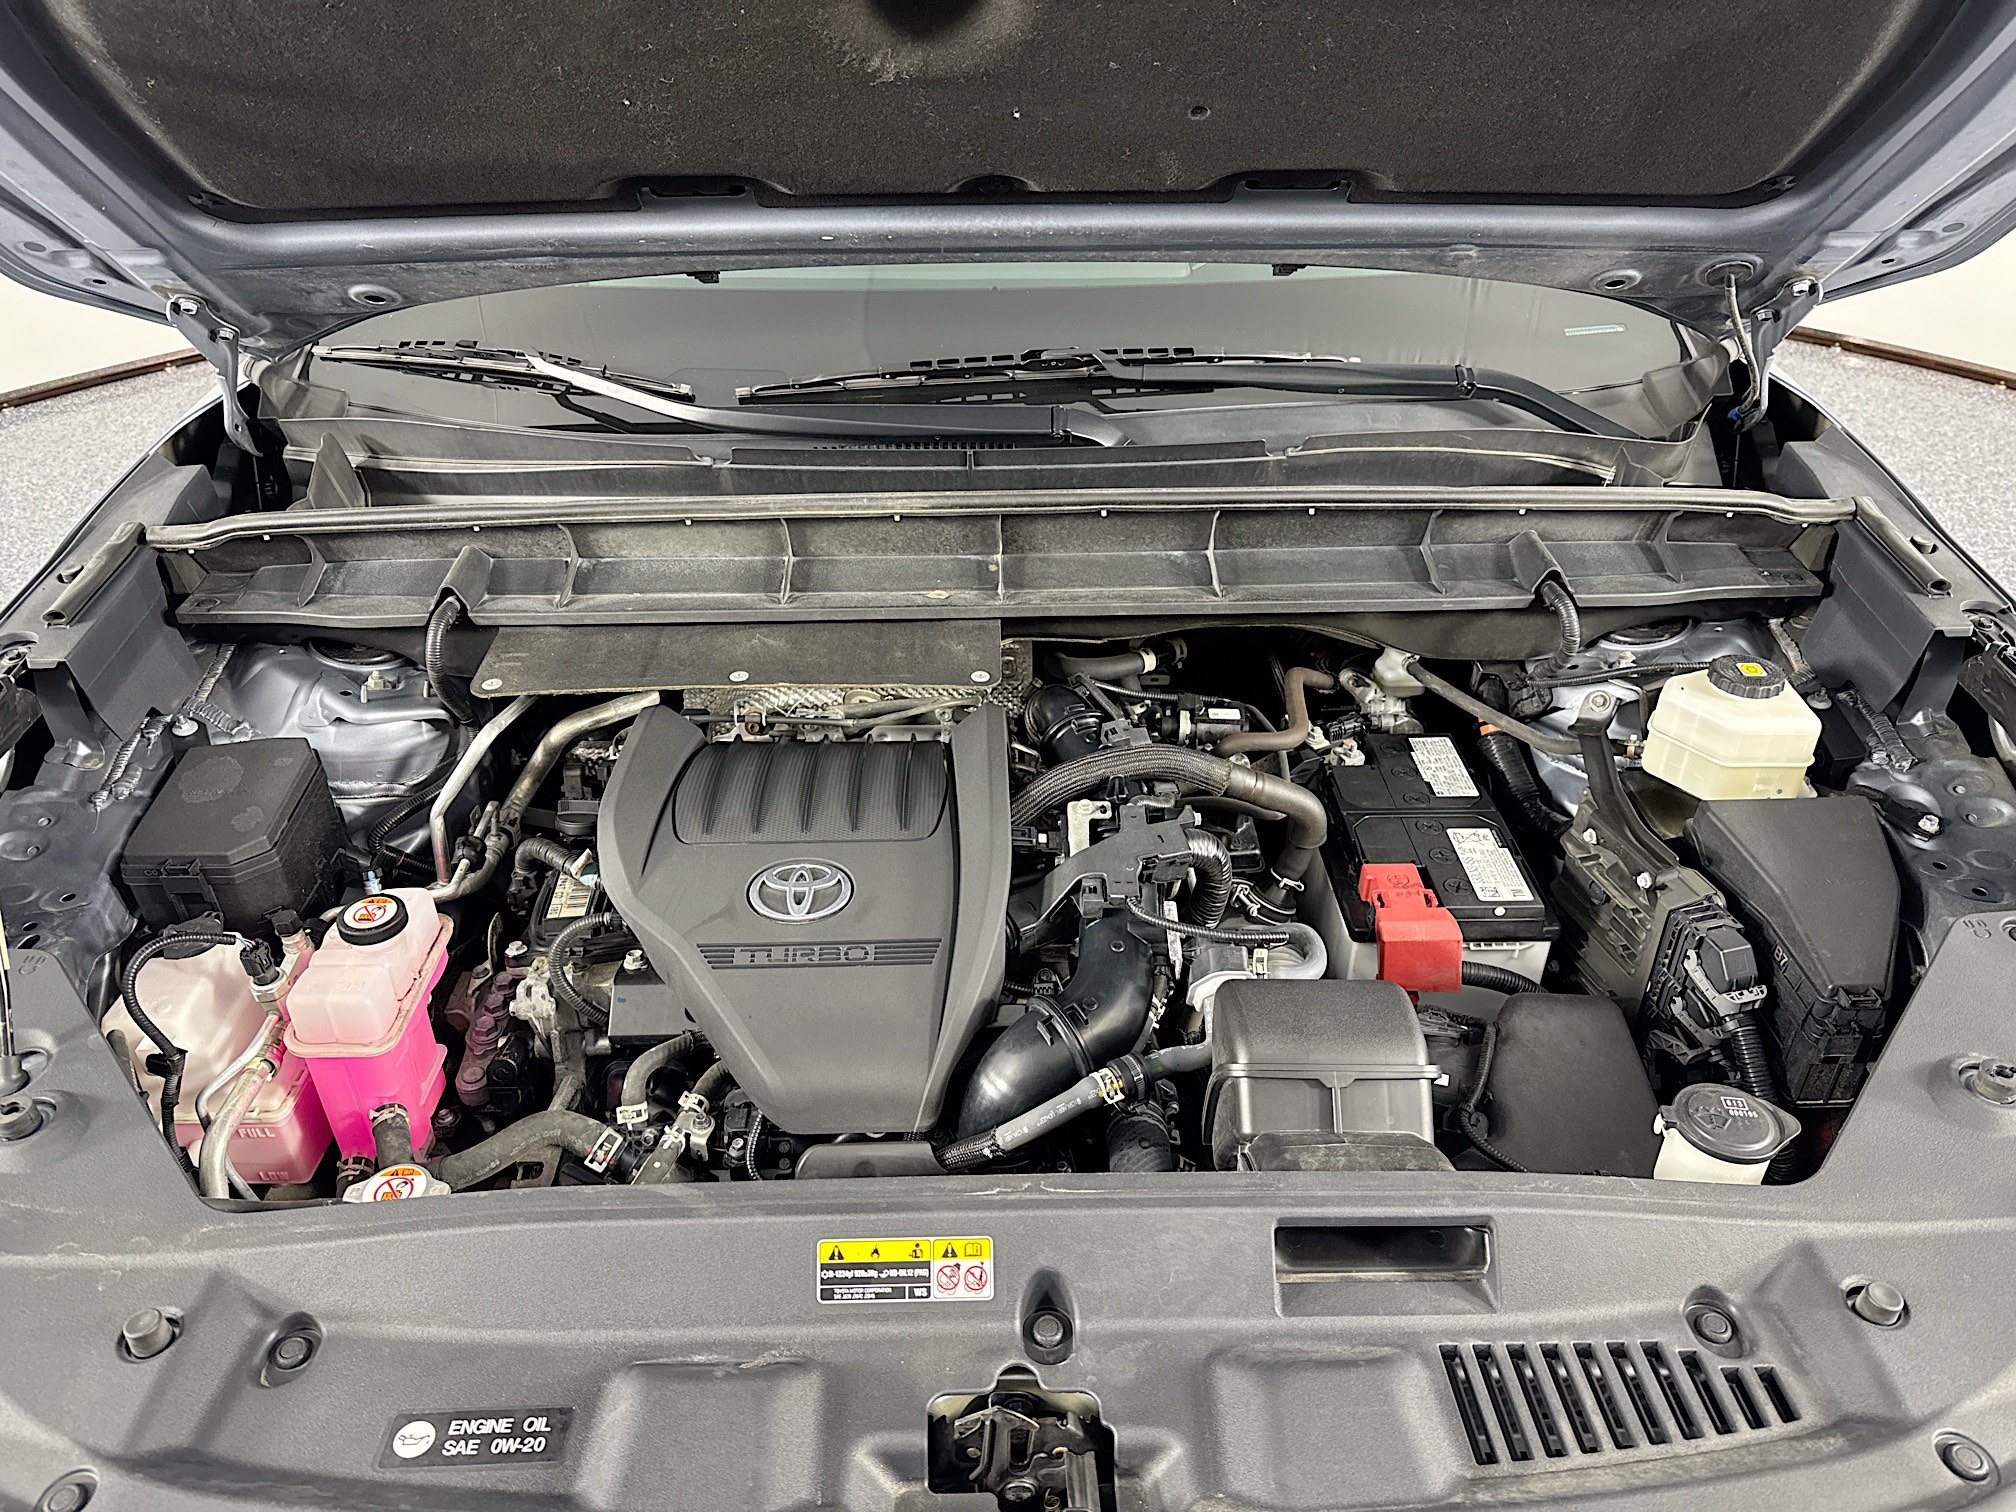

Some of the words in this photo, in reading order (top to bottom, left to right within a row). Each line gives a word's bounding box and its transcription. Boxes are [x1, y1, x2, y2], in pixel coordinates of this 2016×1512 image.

[740, 945, 870, 964] TURBO
[1773, 944, 1789, 967] B7
[237, 1127, 276, 1138] FULL
[258, 1171, 290, 1181] LOW
[913, 1287, 929, 1297] WS
[448, 1417, 515, 1436] ENGINE
[523, 1416, 551, 1433] OIL
[441, 1439, 481, 1456] SAE
[490, 1436, 546, 1454] 0W-20
